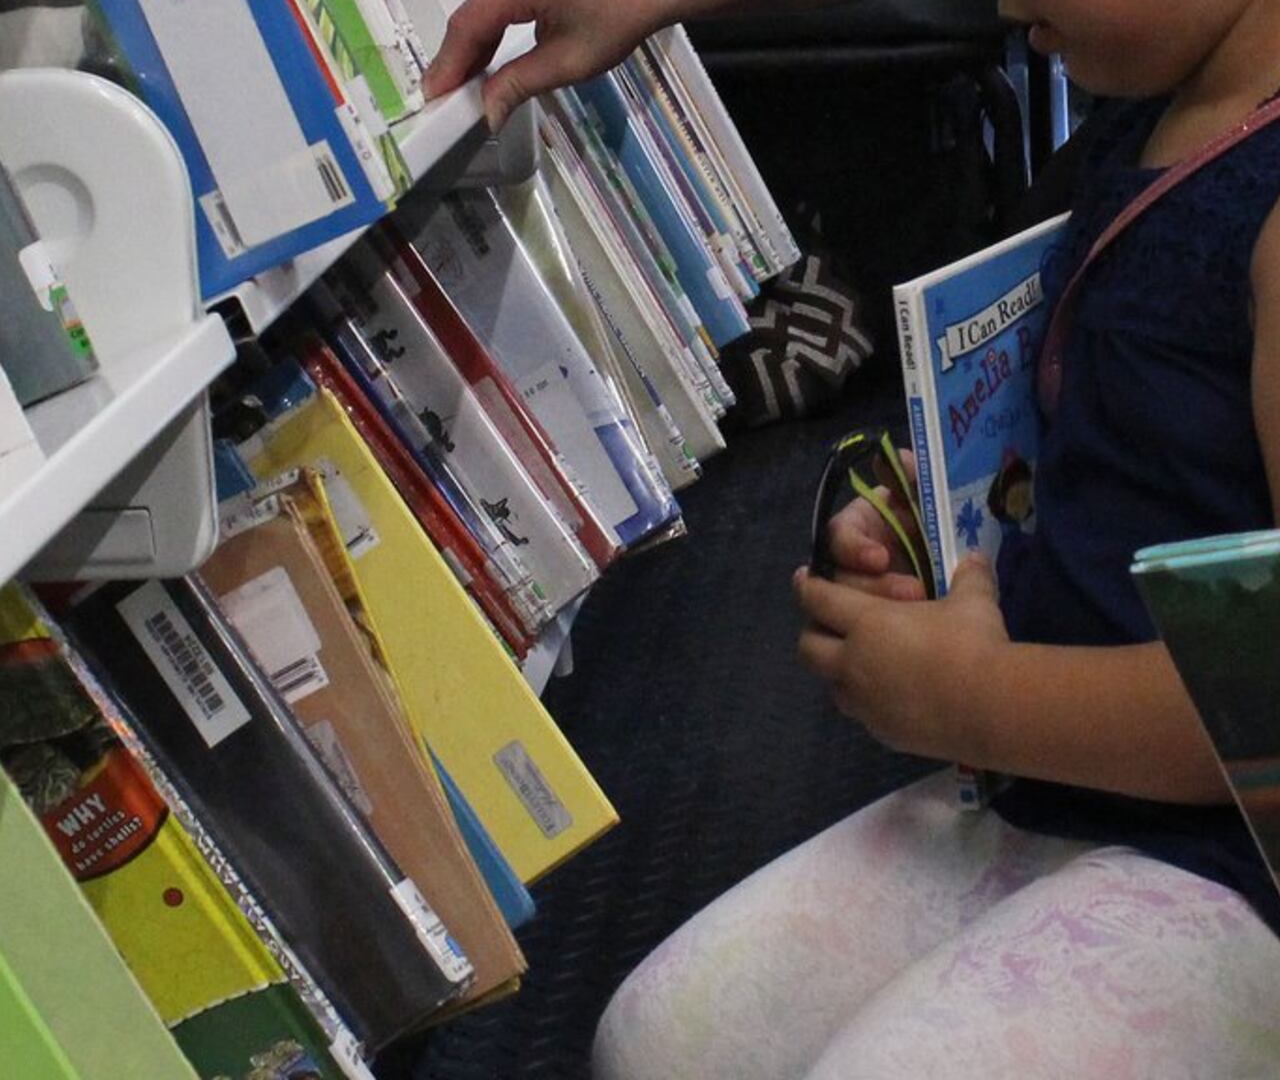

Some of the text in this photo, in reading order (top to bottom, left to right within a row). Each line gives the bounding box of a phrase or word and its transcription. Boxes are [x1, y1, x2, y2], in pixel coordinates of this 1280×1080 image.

[957, 280, 1038, 351] I Can Read!
[949, 348, 1012, 448] Amelia
[57, 793, 105, 837] WHY
[72, 810, 126, 854] do turtles
[76, 816, 142, 871] have shells?
